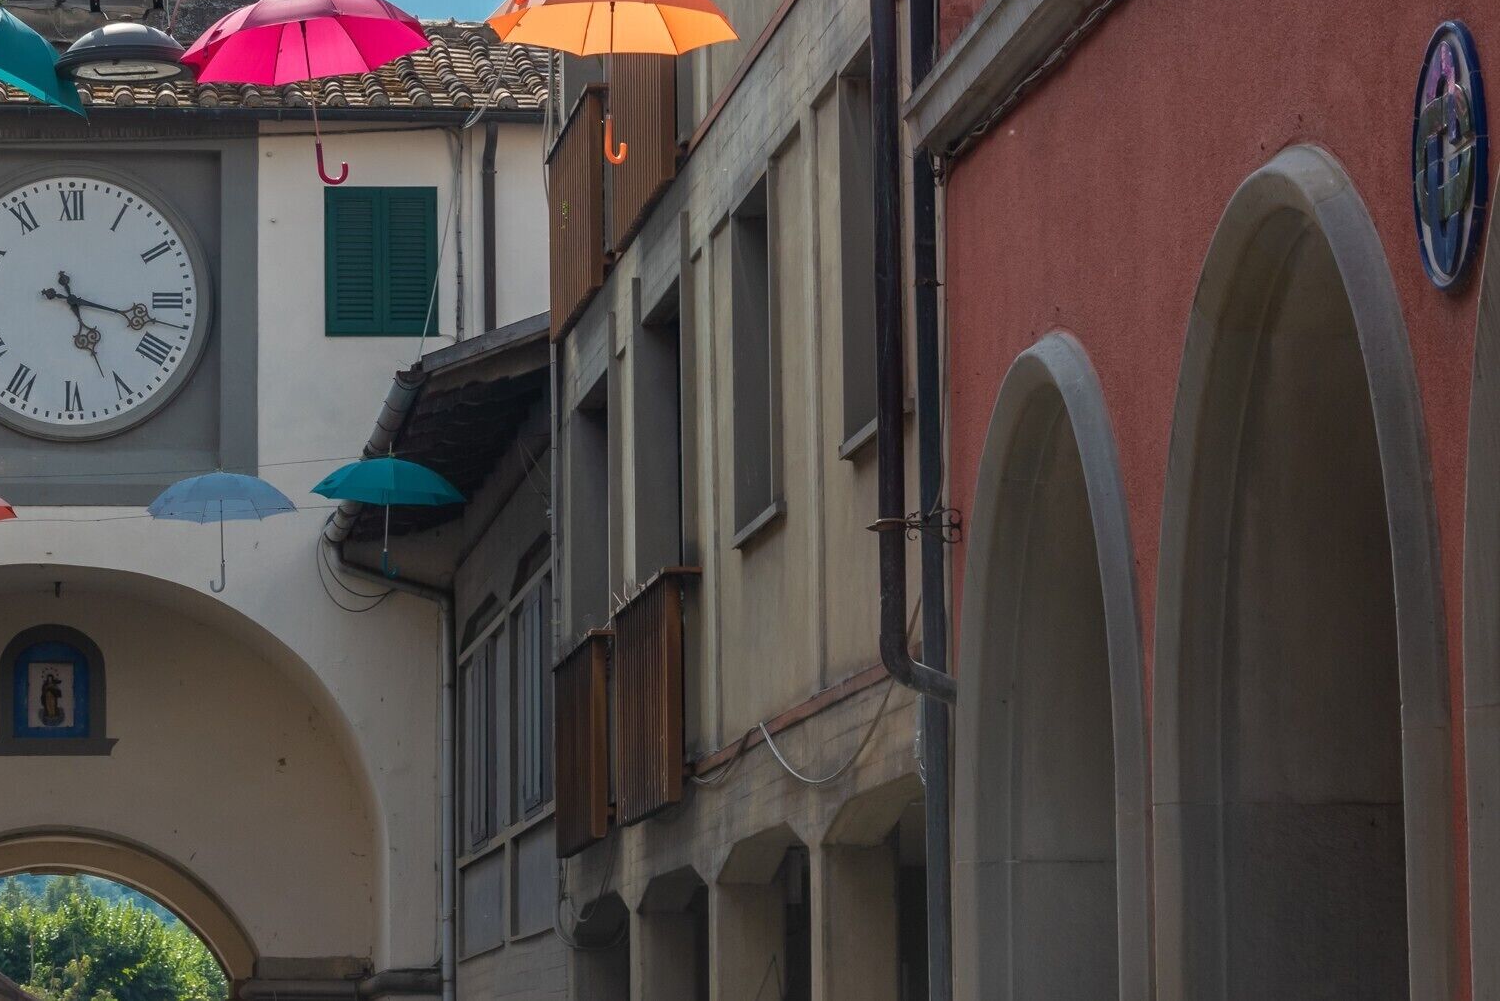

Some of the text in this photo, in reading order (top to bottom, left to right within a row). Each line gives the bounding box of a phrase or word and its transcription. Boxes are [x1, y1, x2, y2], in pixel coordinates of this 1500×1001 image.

[9, 200, 40, 235] XI
[59, 190, 84, 221] XII
[110, 203, 129, 232] I
[140, 240, 172, 264] II
[152, 292, 183, 309] III
[135, 331, 174, 366] IIII
[6, 363, 37, 402] VII
[65, 381, 84, 412] VI
[112, 370, 134, 400] V
